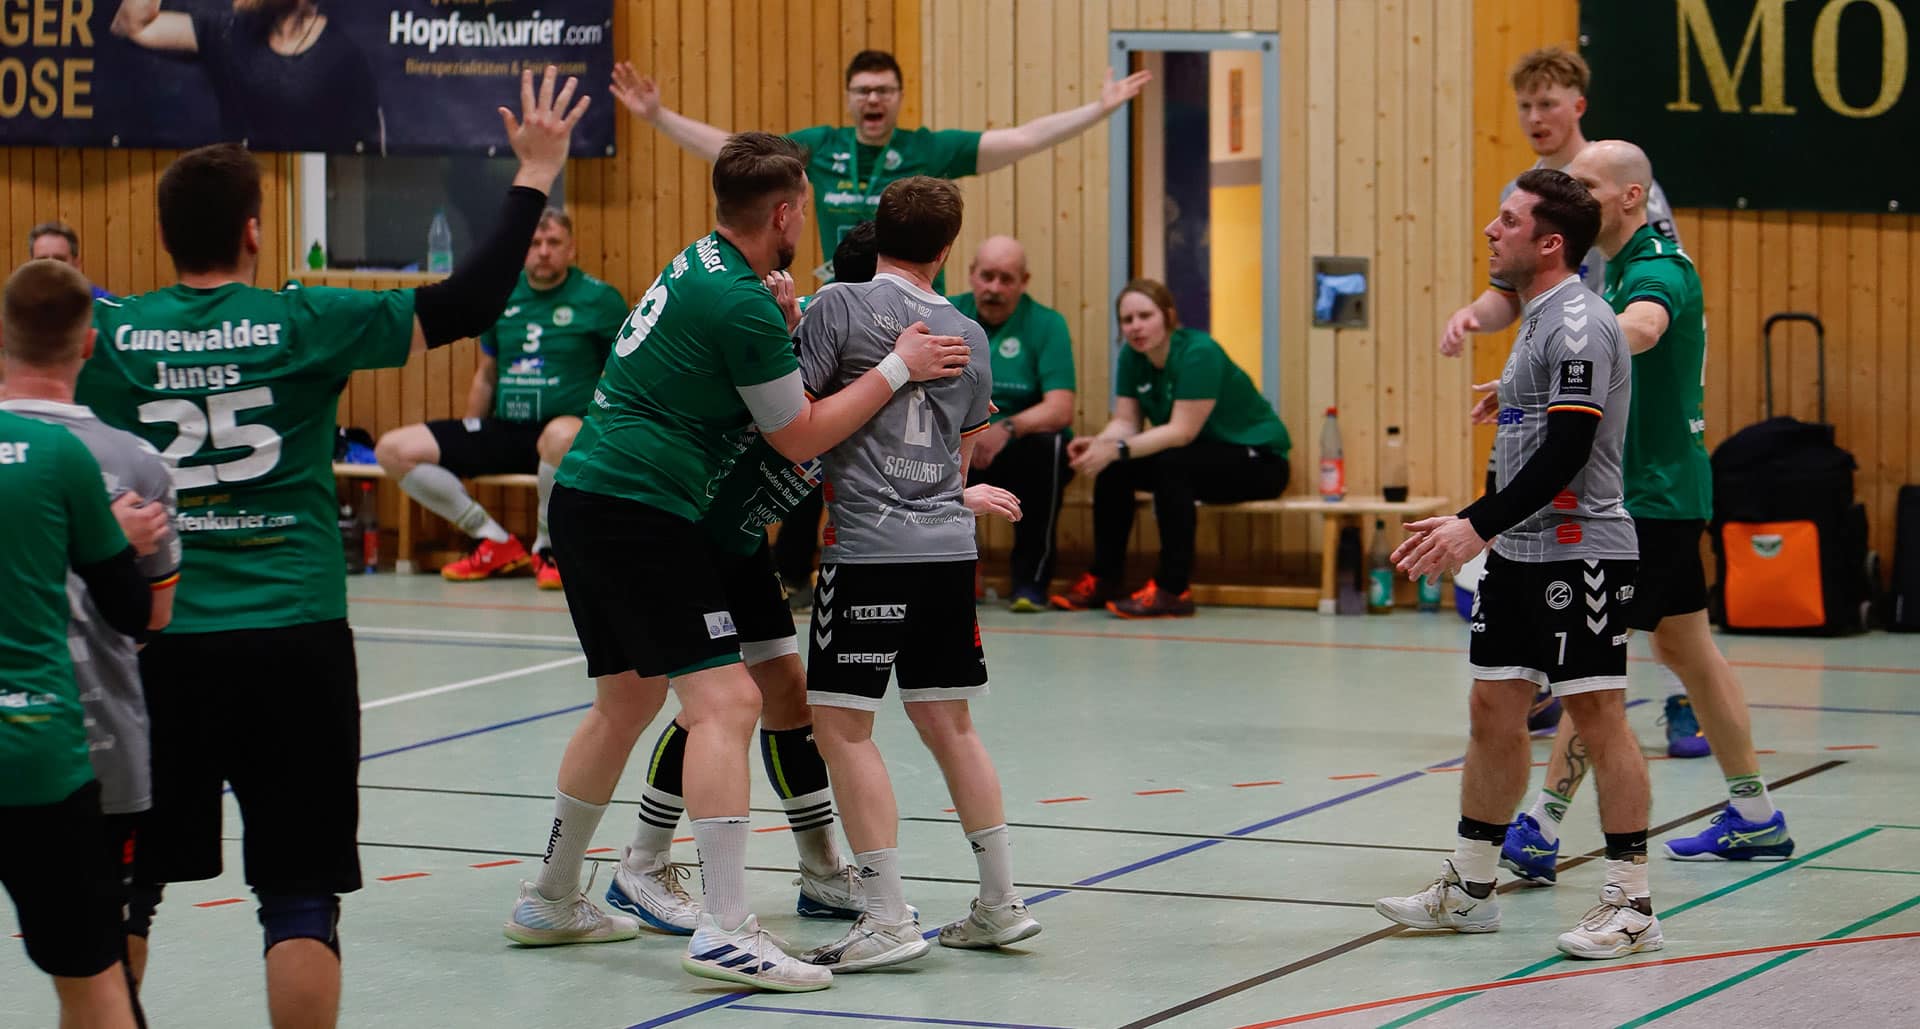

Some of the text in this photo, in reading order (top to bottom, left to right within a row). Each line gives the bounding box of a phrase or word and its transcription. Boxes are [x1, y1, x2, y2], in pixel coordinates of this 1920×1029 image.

[0, 0, 95, 47] GER
[1665, 0, 1908, 118] MO
[0, 58, 95, 119] OSE
[114, 319, 282, 352] Cunewalder
[522, 322, 544, 353] 3
[153, 361, 241, 390] Jungs
[0, 442, 30, 464] er
[137, 386, 283, 490] 25
[1554, 631, 1568, 666] 7
[543, 817, 563, 864] Kempa
